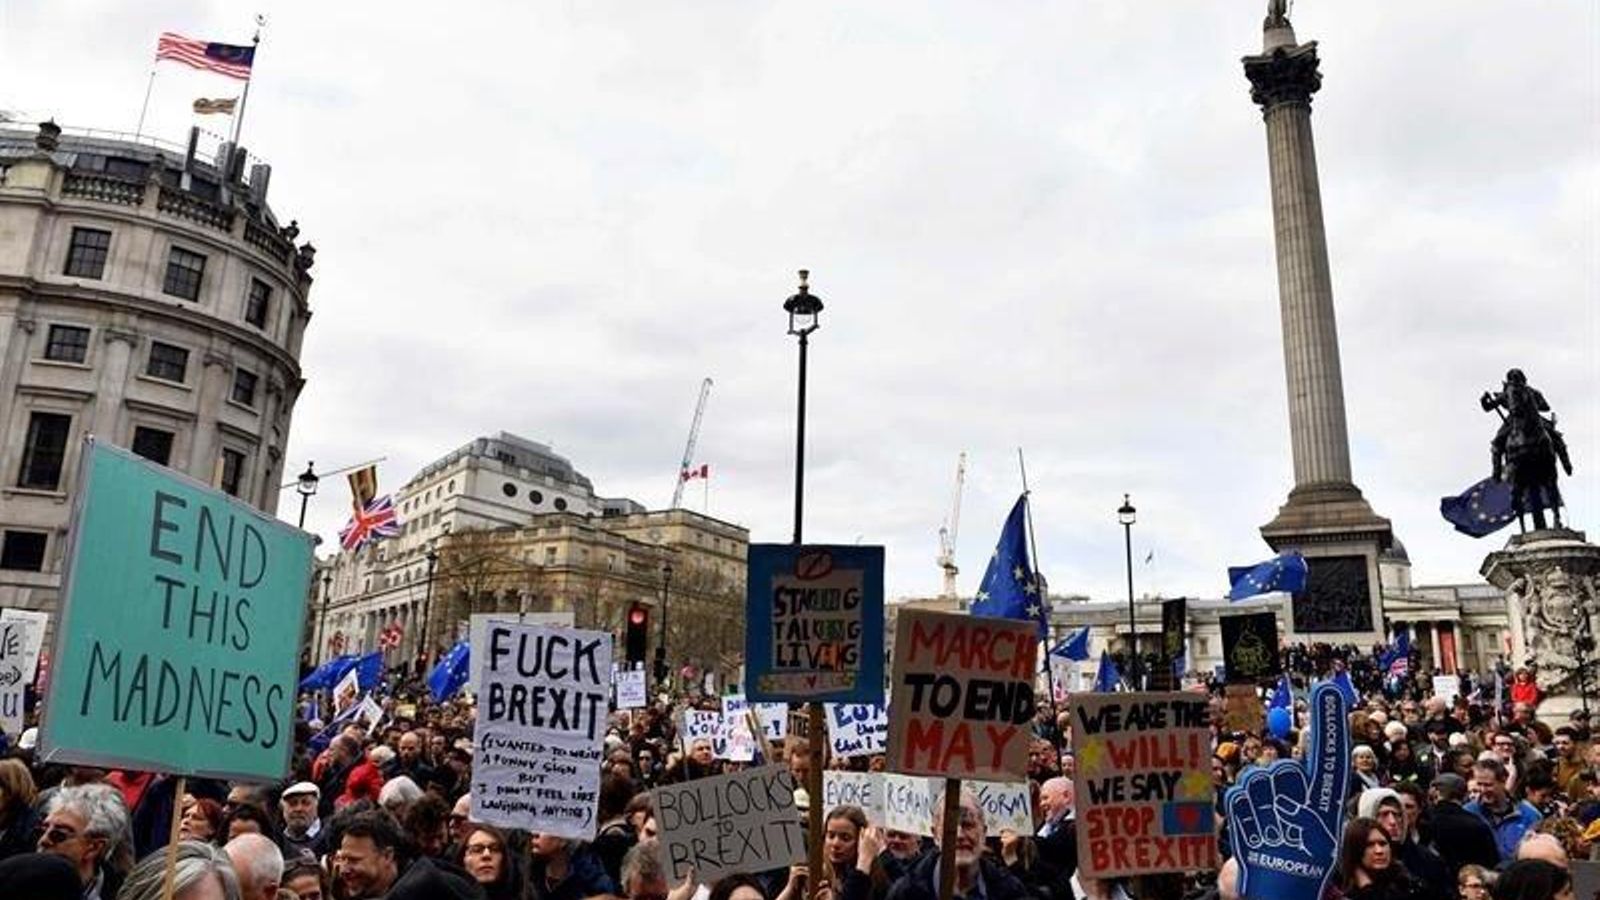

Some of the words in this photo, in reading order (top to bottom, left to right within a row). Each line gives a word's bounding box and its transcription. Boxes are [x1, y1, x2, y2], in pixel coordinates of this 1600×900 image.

[151, 490, 267, 589] END
[155, 575, 250, 651] THIS
[491, 628, 601, 684] FUCK
[907, 619, 1036, 679] MARCH
[80, 641, 283, 749] MADNESS
[488, 682, 603, 741] BREXIT
[904, 673, 962, 718] TO
[963, 679, 1036, 725] END
[1077, 704, 1120, 735] WE
[1124, 704, 1168, 731] ARE
[1170, 701, 1210, 730] THE
[1325, 695, 1337, 753] BOLLOCKS
[481, 754, 490, 765] A
[494, 754, 537, 769] FUNNY
[495, 740, 546, 753] WANTED
[904, 717, 1019, 773] MAY
[1107, 733, 1198, 770] WILL!
[1324, 756, 1336, 771] TO
[518, 773, 548, 783] BUT
[537, 788, 568, 800] FEEL
[1088, 776, 1124, 804] WE
[1130, 772, 1182, 801] SAY
[1319, 772, 1334, 812] BREXIT
[658, 771, 794, 832] BOLLOCKS
[712, 820, 735, 834] TO
[1086, 805, 1154, 839] STOP
[669, 820, 797, 880] BREXIT
[1090, 836, 1216, 871] BREXIT!
[1259, 854, 1325, 877] EUROPEAN
